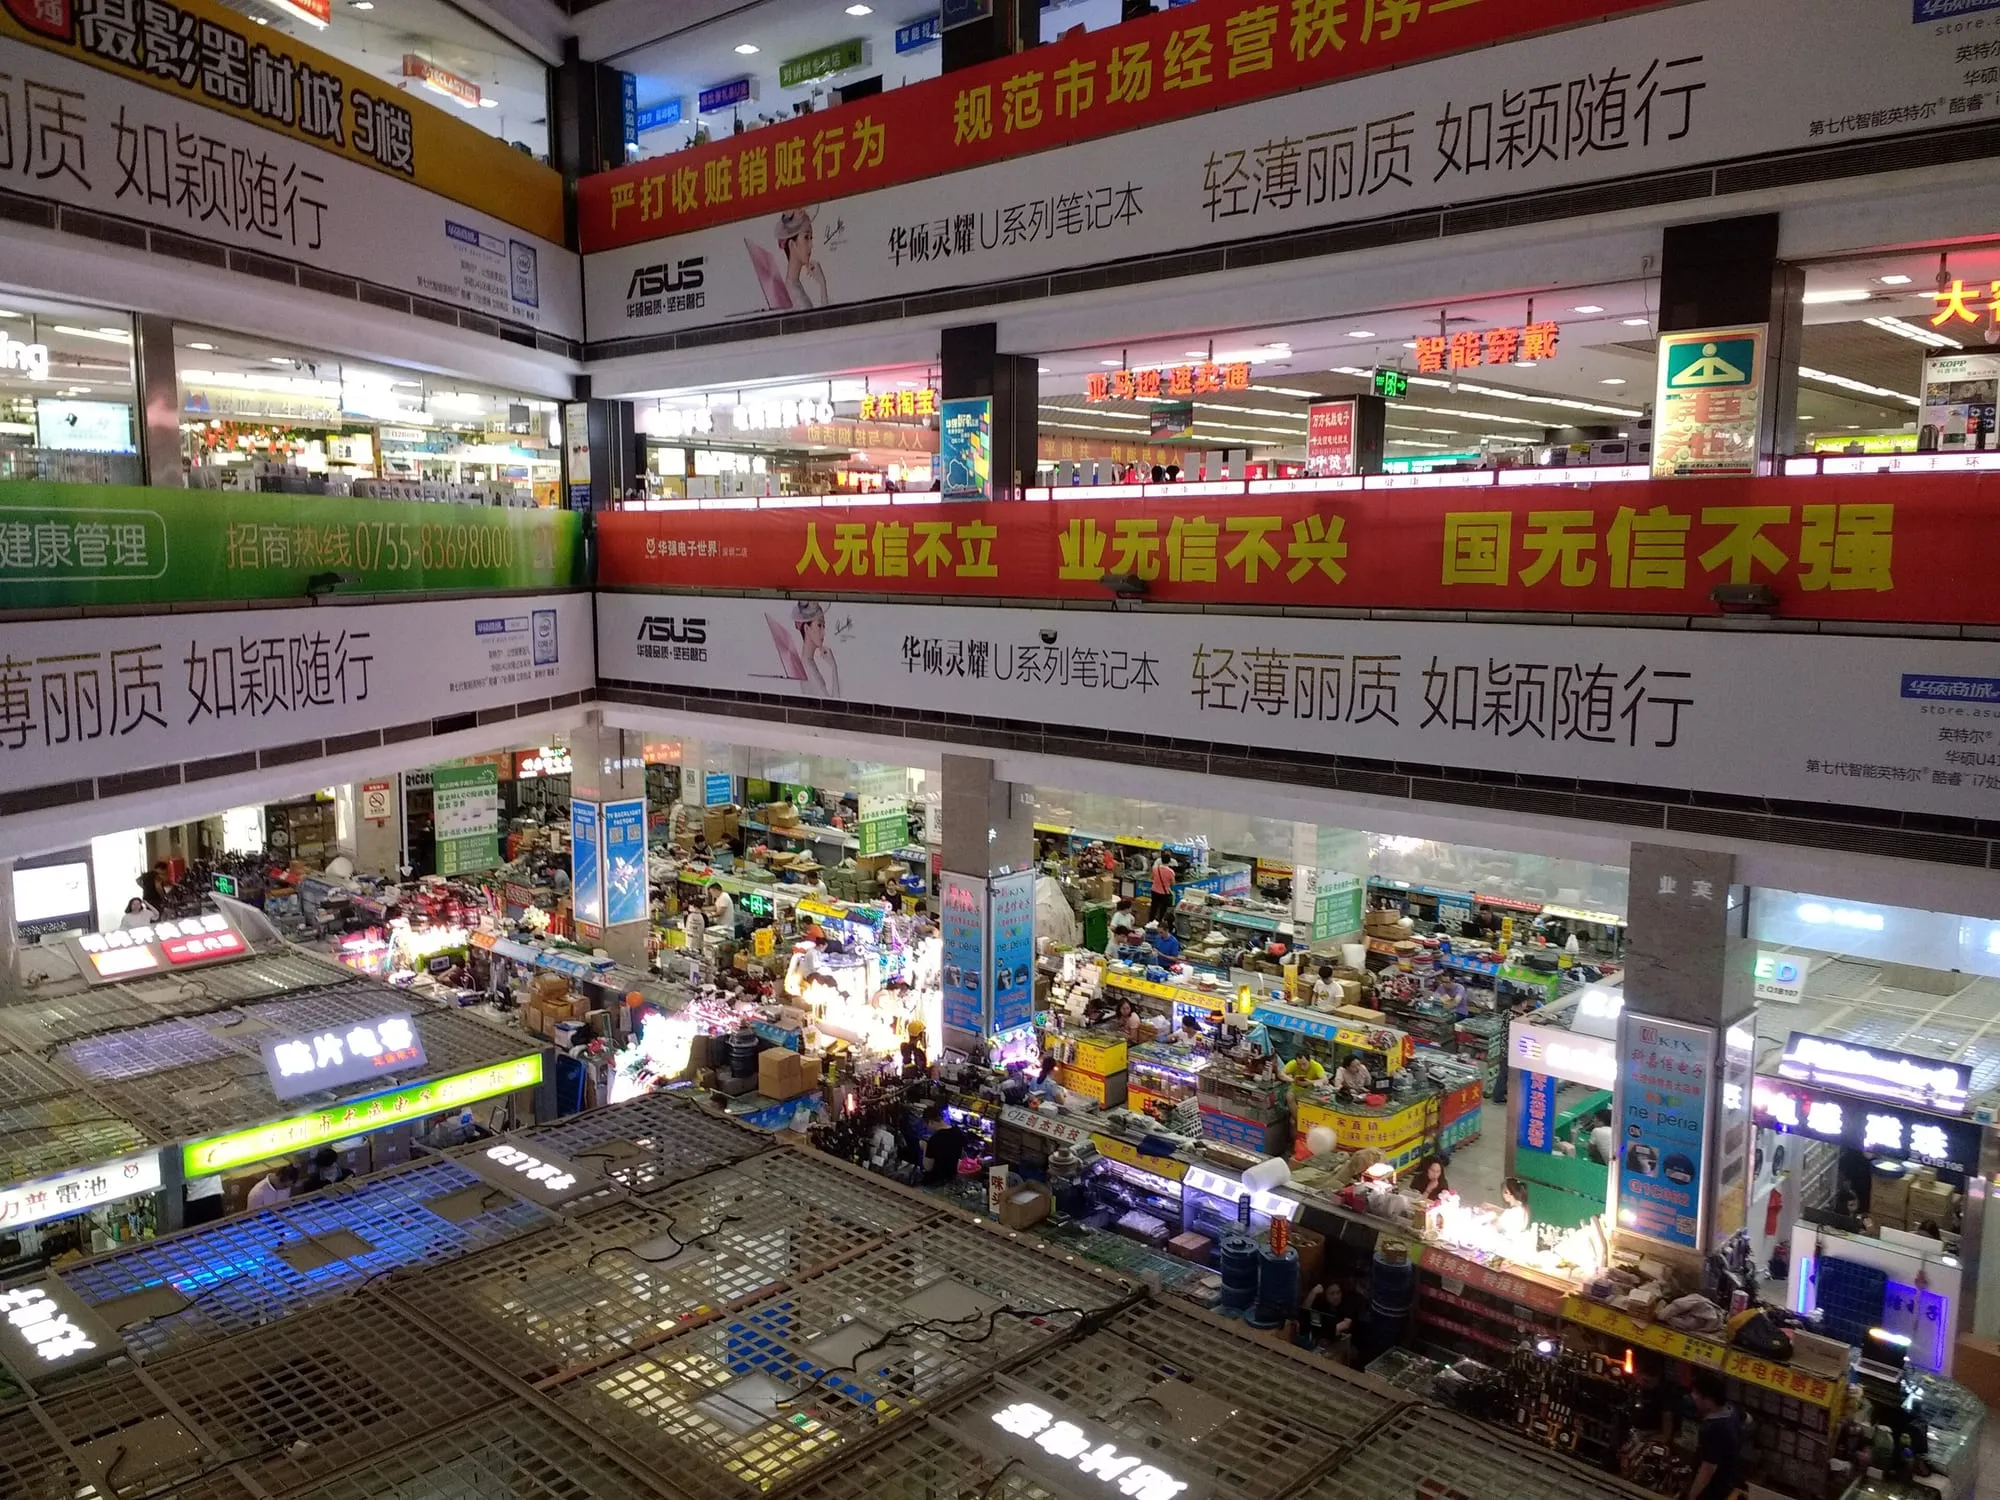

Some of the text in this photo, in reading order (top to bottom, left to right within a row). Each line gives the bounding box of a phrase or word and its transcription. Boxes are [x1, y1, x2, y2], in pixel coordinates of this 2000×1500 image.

[954, 0, 1484, 146] 规范市场经营秩序
[352, 90, 413, 175] 3楼
[1203, 55, 1707, 223] 轻薄丽质 如颖随行
[110, 104, 328, 250] 如颖随行
[610, 116, 887, 230] 严打收赃销赃行为
[887, 181, 1144, 268] 华硕灵耀U系列笔记本
[626, 256, 704, 299] ASUS
[1414, 320, 1560, 374] 智能穿戴
[1939, 360, 1967, 368] KOPP
[1167, 360, 1251, 396] 速卖通
[860, 388, 937, 420] 京东淘宝
[0, 522, 149, 569] 健康管理
[227, 522, 352, 570] 招商热线
[355, 521, 513, 571] 0755-83698000
[658, 540, 718, 558] 华强电子世界
[796, 520, 999, 579] 人无信不立
[1058, 514, 1348, 585] 业无信不兴
[1441, 503, 1895, 592] 国无信不强
[637, 616, 706, 643] ASUS
[183, 629, 374, 726] 如颖随行
[900, 634, 1161, 695] 华硕灵耀U系列笔记本
[1908, 679, 1993, 698] 华硕商城
[1191, 643, 1695, 748] 轻薄丽质 如颖随行
[613, 817, 635, 826] FACTORY
[614, 809, 641, 818] BACKLIGHT
[1025, 1114, 1081, 1142] 创杰科技
[1321, 1113, 1379, 1131] 厂家直销
[1428, 1253, 1471, 1278] 转换头
[1731, 1354, 1829, 1400] 光电传感器
